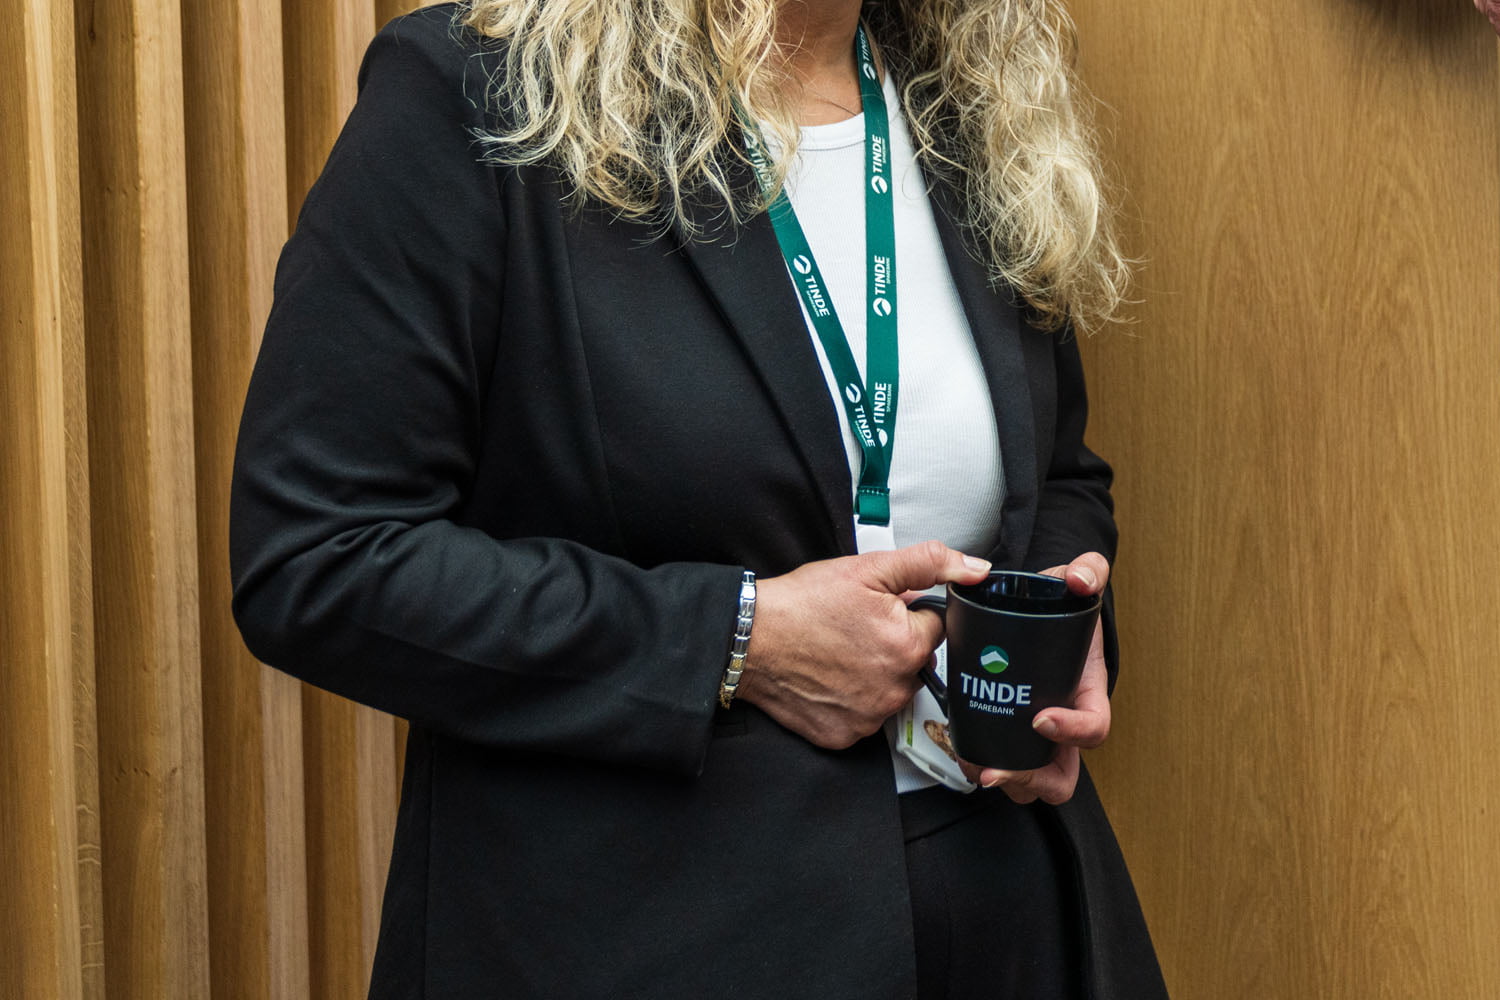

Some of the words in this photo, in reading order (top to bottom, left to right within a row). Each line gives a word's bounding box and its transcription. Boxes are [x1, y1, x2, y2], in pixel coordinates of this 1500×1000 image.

[872, 133, 882, 173] TINDE
[874, 255, 886, 295] TINDE
[804, 275, 830, 317] TINDE
[874, 382, 887, 424] TINDE
[854, 405, 876, 447] TINDE
[960, 672, 1032, 705] TINDE
[969, 700, 1015, 715] SPAREBANK
